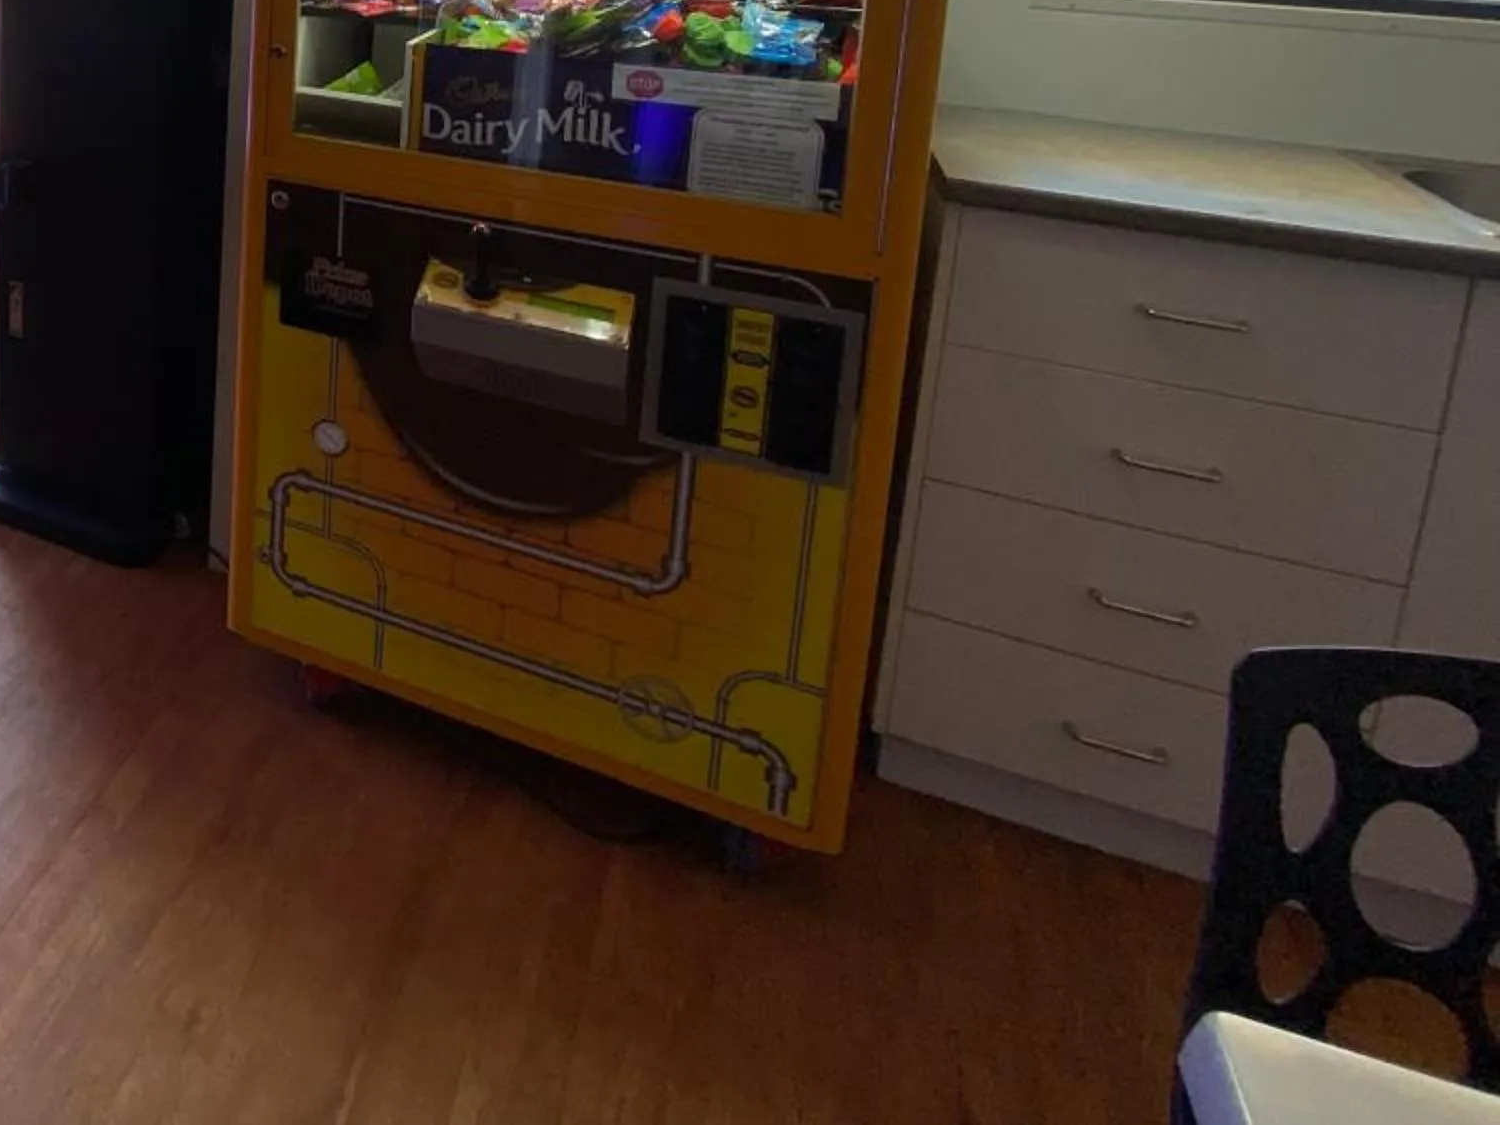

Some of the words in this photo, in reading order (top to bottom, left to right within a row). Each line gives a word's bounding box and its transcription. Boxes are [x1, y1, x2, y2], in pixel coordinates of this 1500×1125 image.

[628, 77, 662, 92] STOP
[422, 102, 531, 154] Dairy
[535, 107, 633, 156] Milk
